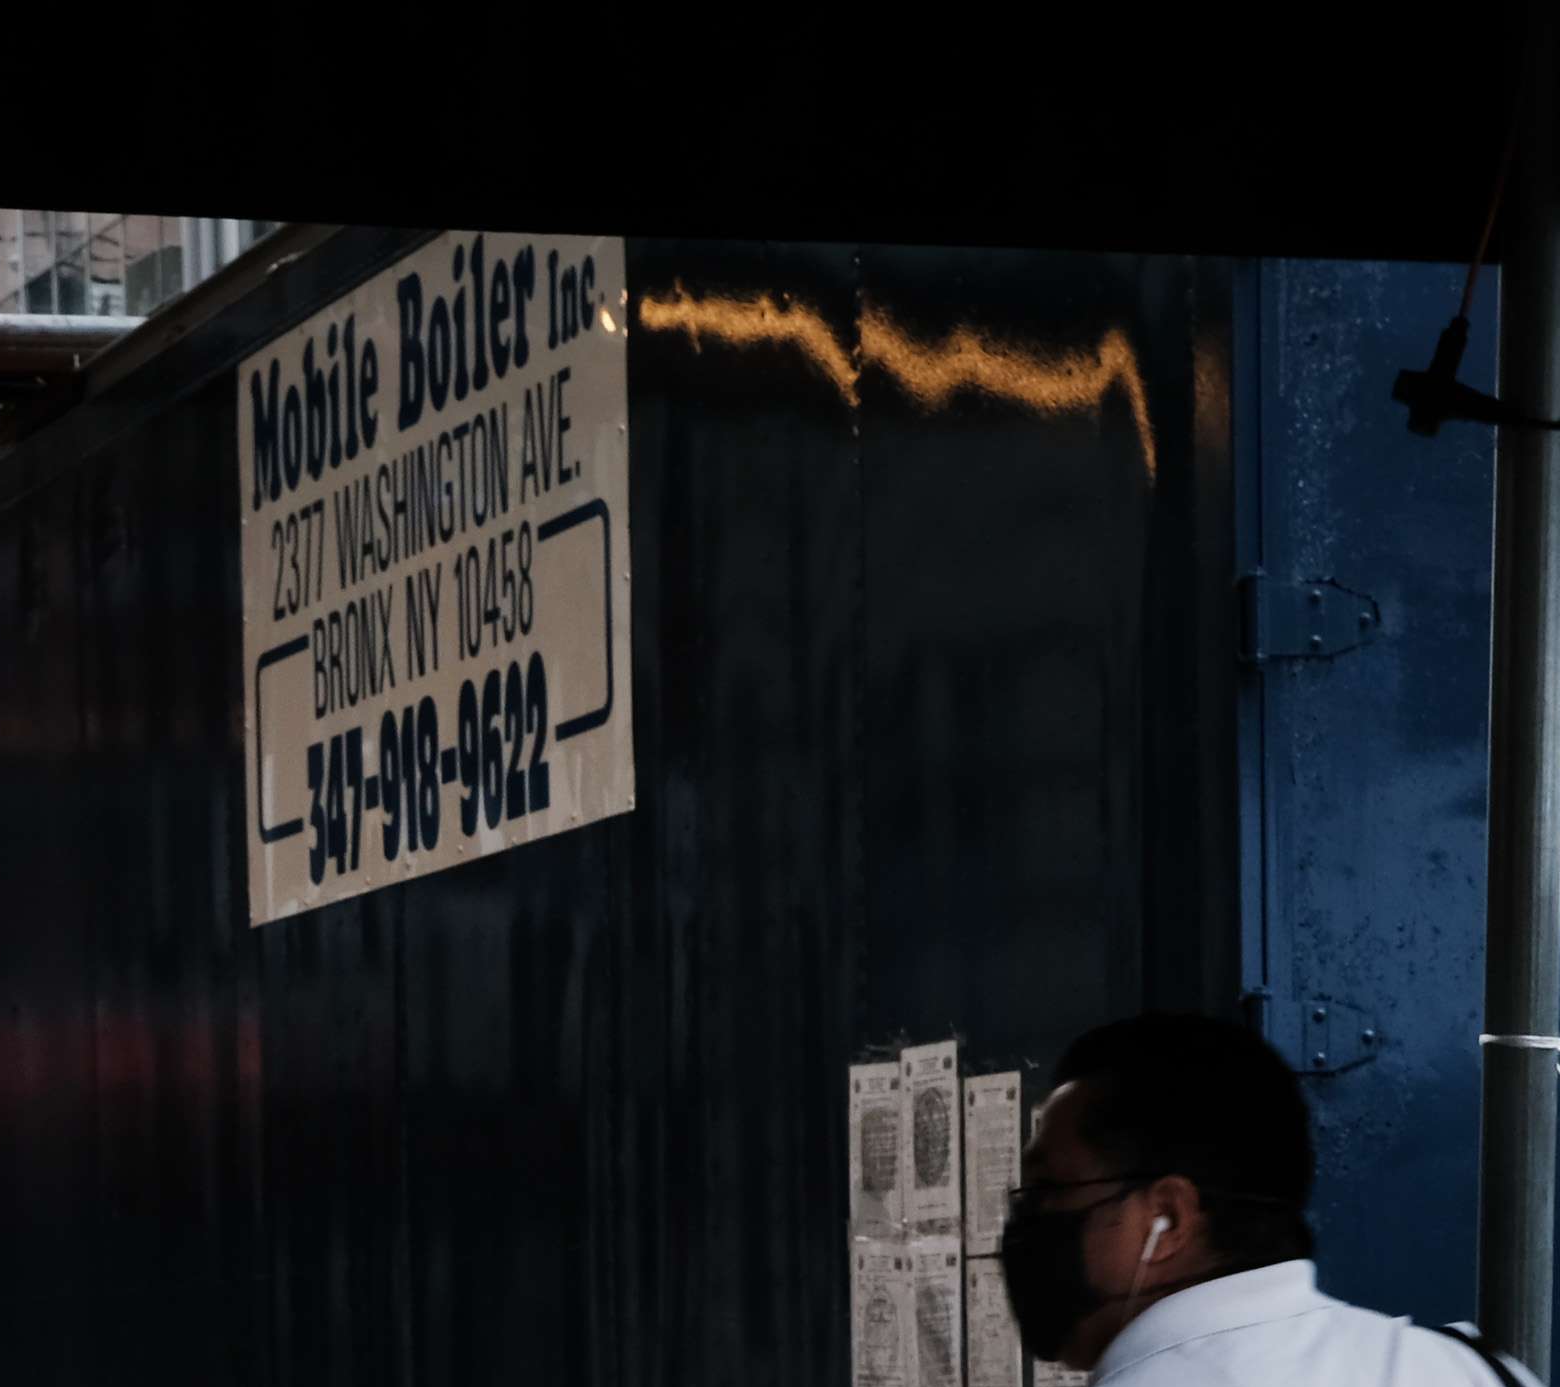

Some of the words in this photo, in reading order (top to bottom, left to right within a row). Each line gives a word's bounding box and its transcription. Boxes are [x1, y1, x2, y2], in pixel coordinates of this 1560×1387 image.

[251, 310, 378, 510] Mobile
[396, 231, 535, 434] Boiler
[271, 498, 325, 622] 2377
[334, 402, 509, 590] WASHINGTON
[520, 367, 582, 496] AVE.
[312, 579, 394, 720] BRONX
[406, 567, 442, 679] NY
[453, 520, 535, 662] 10458
[306, 649, 550, 885] 347-918-9622
